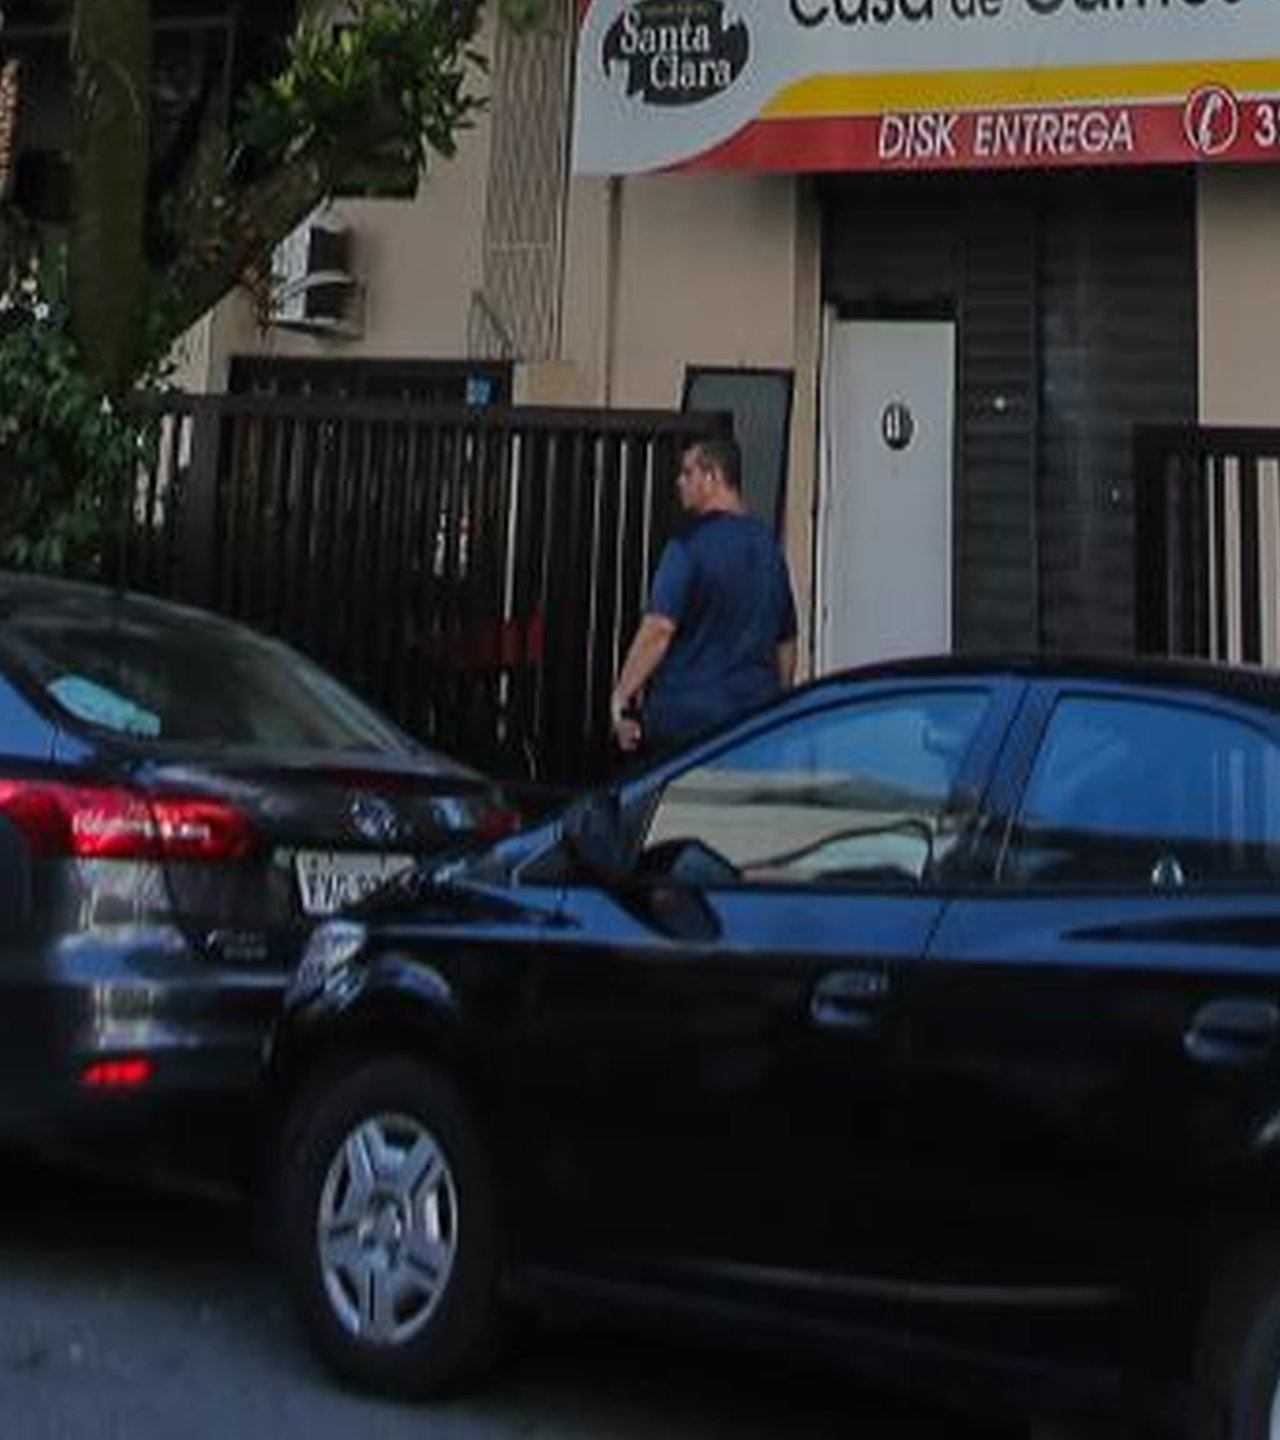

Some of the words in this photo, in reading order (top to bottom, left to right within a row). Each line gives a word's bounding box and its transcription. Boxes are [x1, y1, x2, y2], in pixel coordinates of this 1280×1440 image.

[620, 9, 709, 54] Santa
[650, 54, 731, 89] Clara
[878, 114, 958, 159] DISK
[974, 111, 1133, 155] ENTREGA
